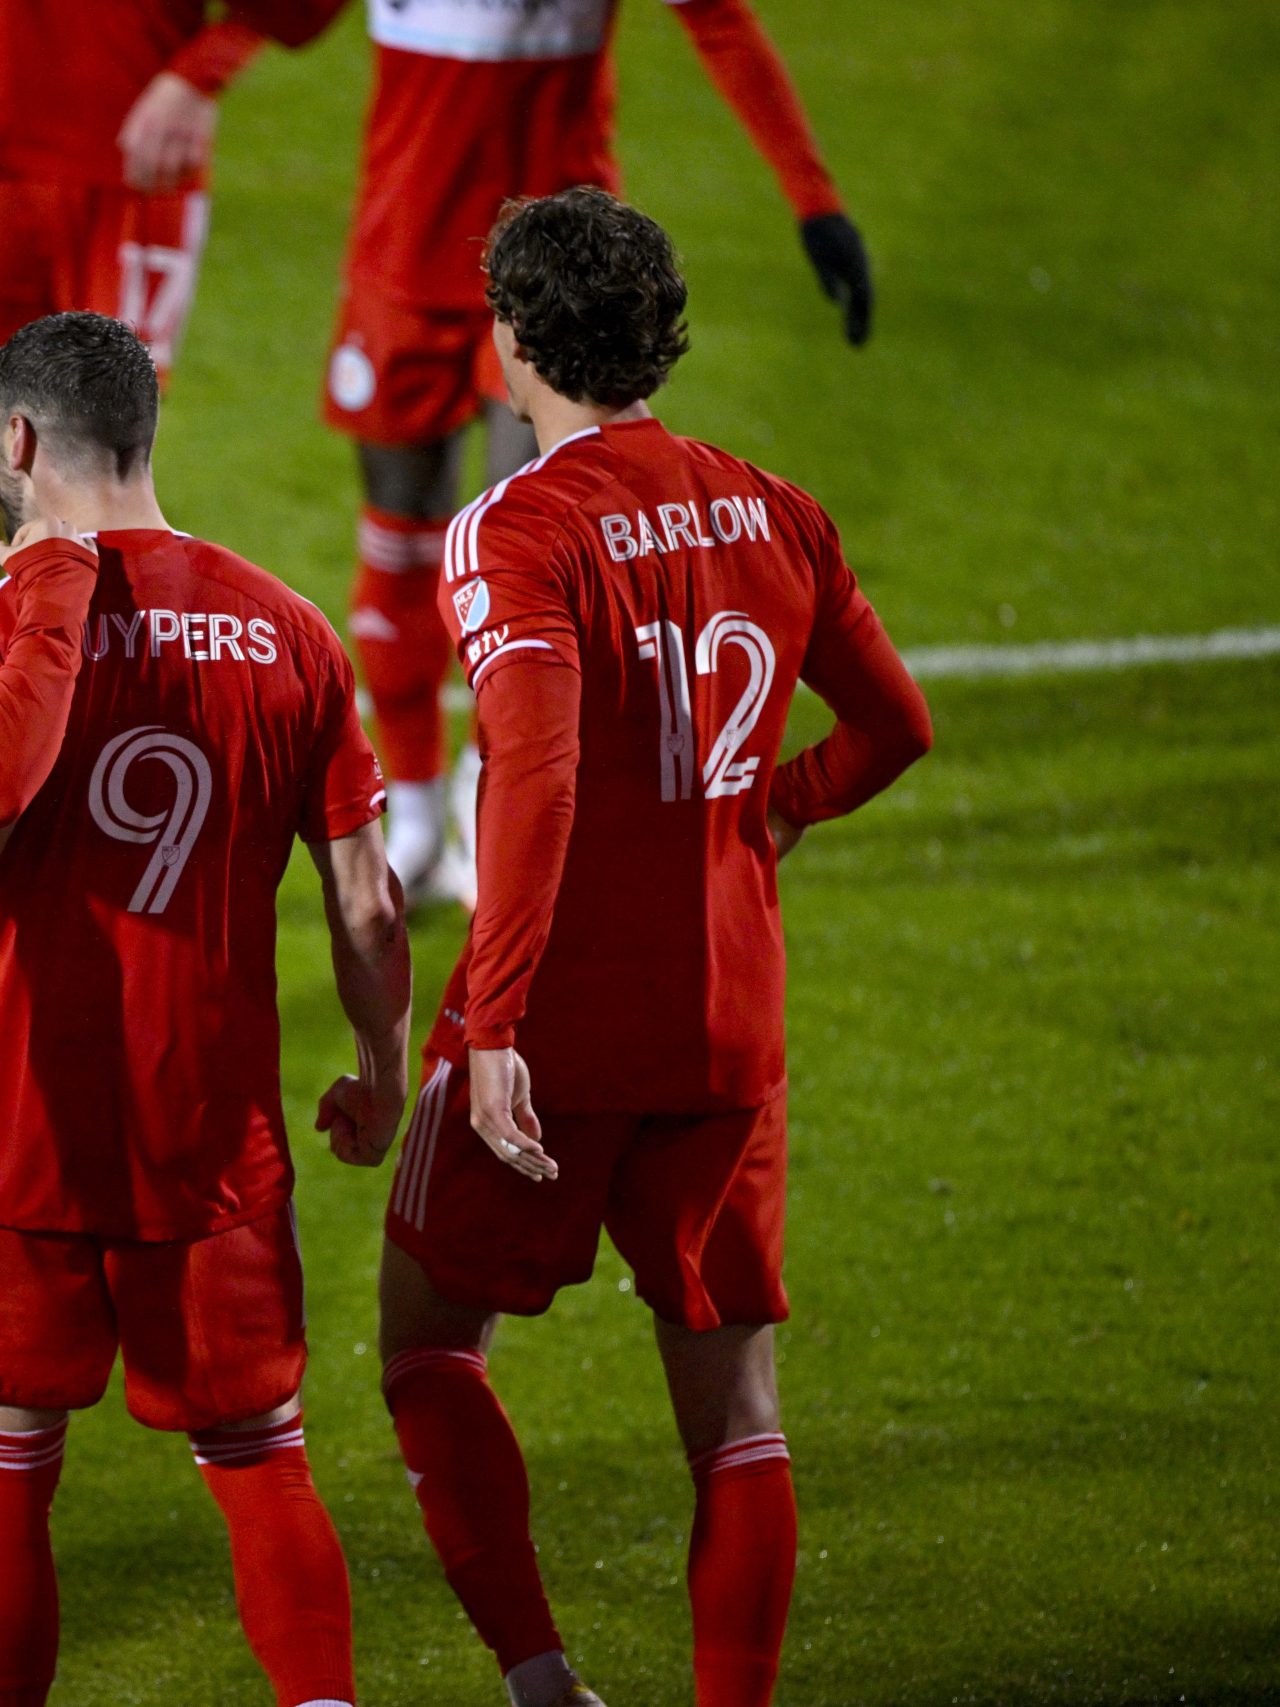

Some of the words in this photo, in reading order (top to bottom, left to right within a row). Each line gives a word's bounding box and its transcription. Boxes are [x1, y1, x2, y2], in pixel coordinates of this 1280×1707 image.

[119, 242, 194, 334] 17
[600, 496, 770, 561] BARLOW
[83, 609, 277, 664] UYPERS
[636, 611, 776, 802] 12
[88, 725, 213, 914] 9
